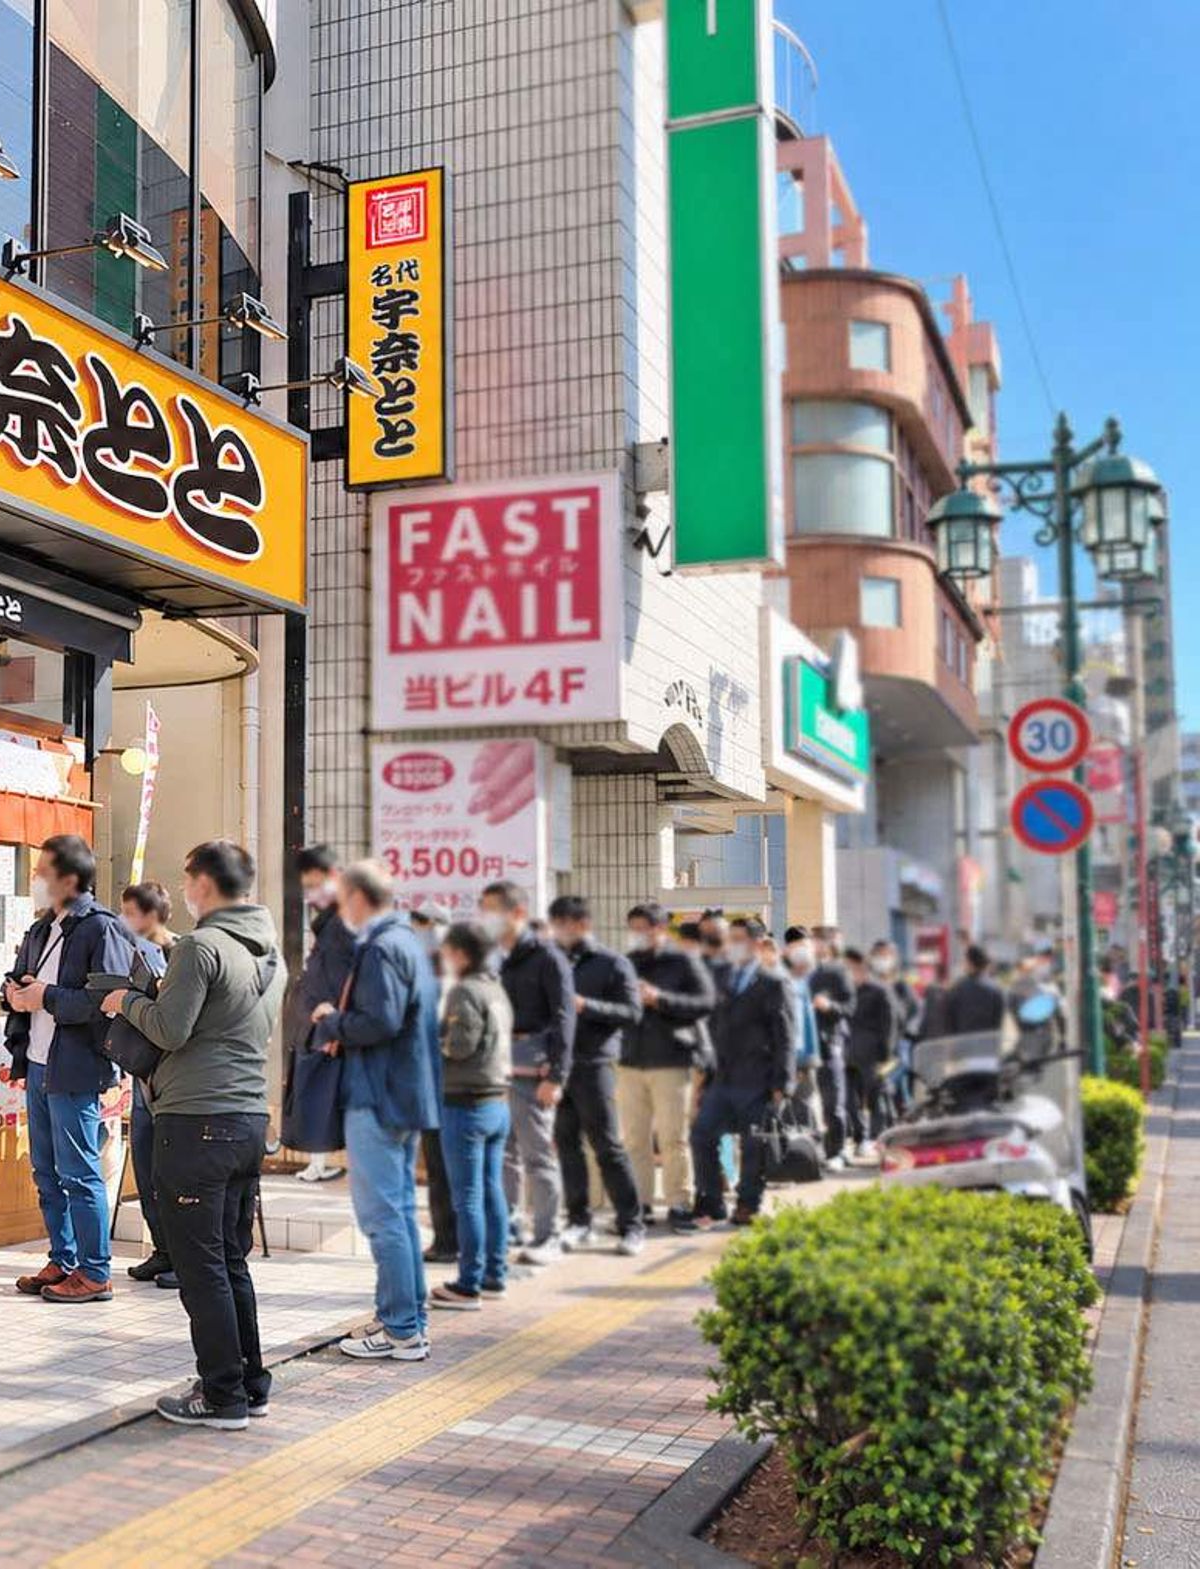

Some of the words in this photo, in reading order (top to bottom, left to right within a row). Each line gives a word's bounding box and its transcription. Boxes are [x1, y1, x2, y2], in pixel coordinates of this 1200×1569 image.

[370, 258, 420, 288] 名代
[371, 289, 420, 458] 宇奈とと
[399, 496, 591, 565] FAST
[407, 556, 579, 586] ファストネイル
[398, 579, 591, 647] NAIL
[1025, 720, 1072, 754] 30
